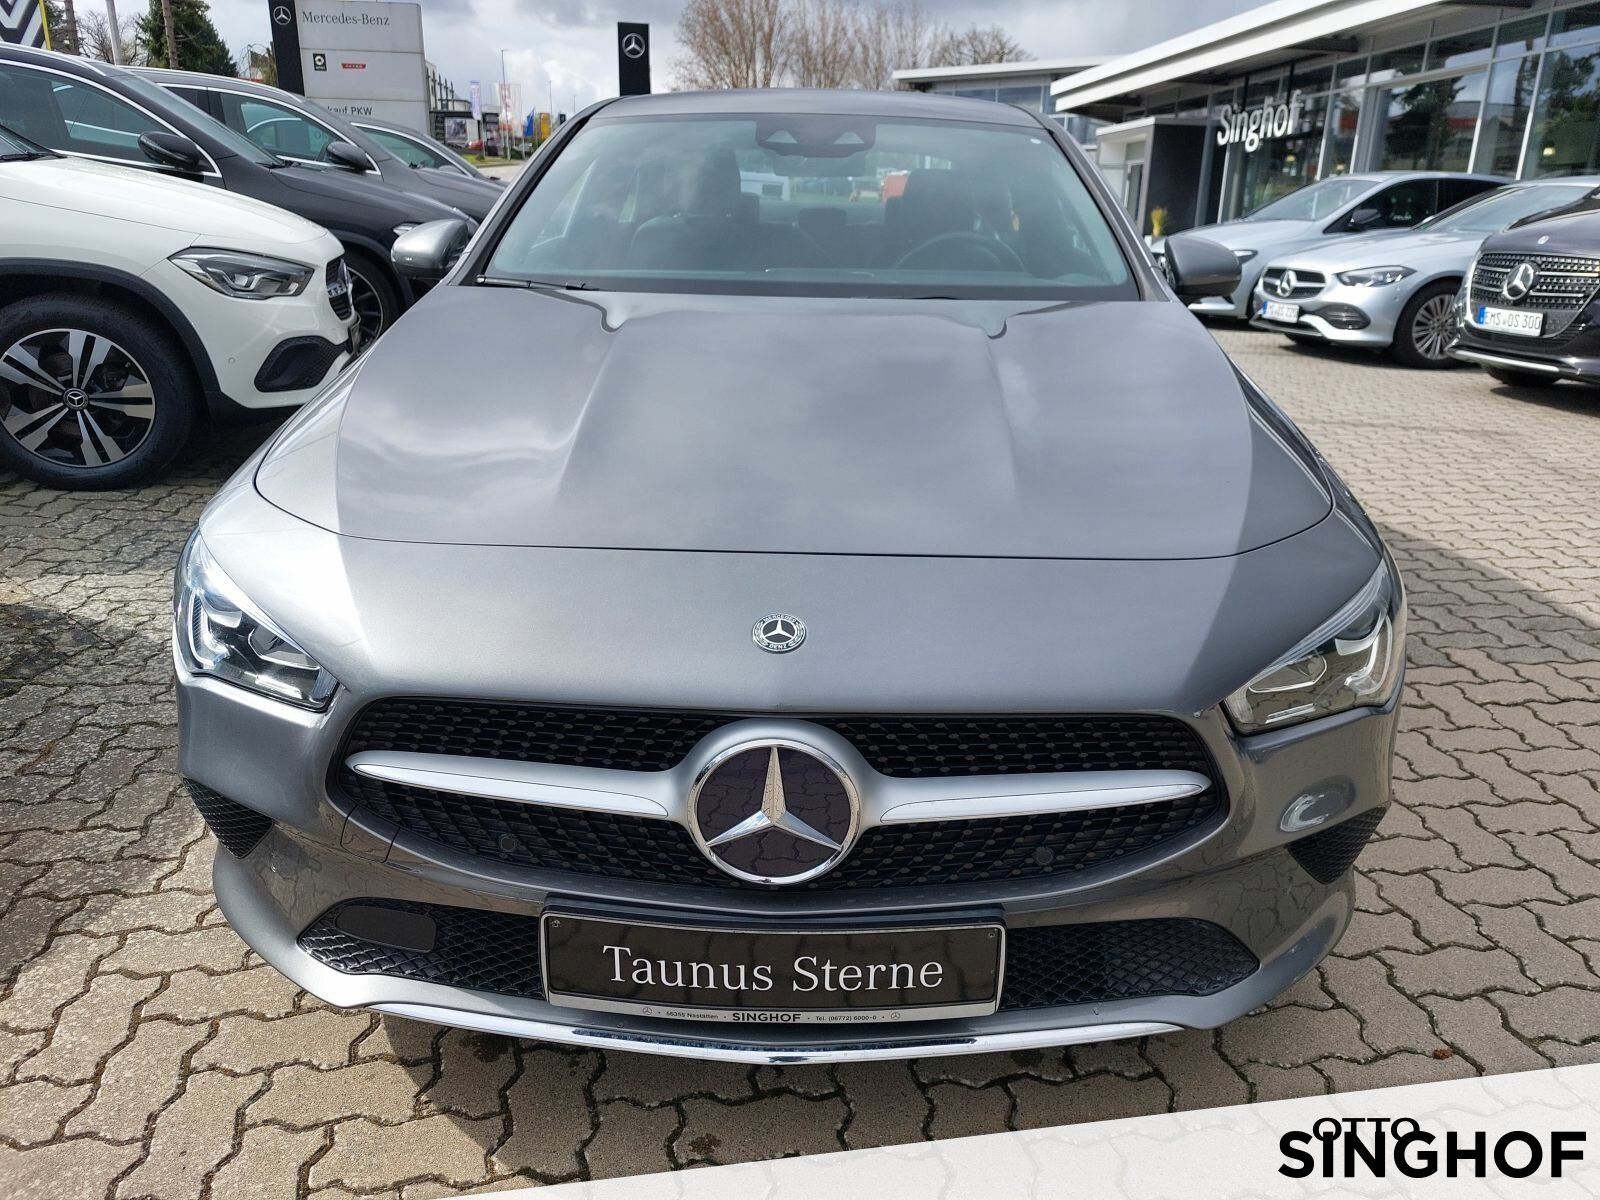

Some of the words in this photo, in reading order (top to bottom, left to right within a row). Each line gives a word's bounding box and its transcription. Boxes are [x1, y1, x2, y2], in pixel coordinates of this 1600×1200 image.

[302, 11, 391, 26] Mercedes-Benz
[350, 106, 372, 116] PKW
[1217, 89, 1304, 153] Singhof
[602, 945, 773, 991] Taunus
[792, 956, 943, 992] Sterne
[732, 1012, 802, 1023] SINGHOF
